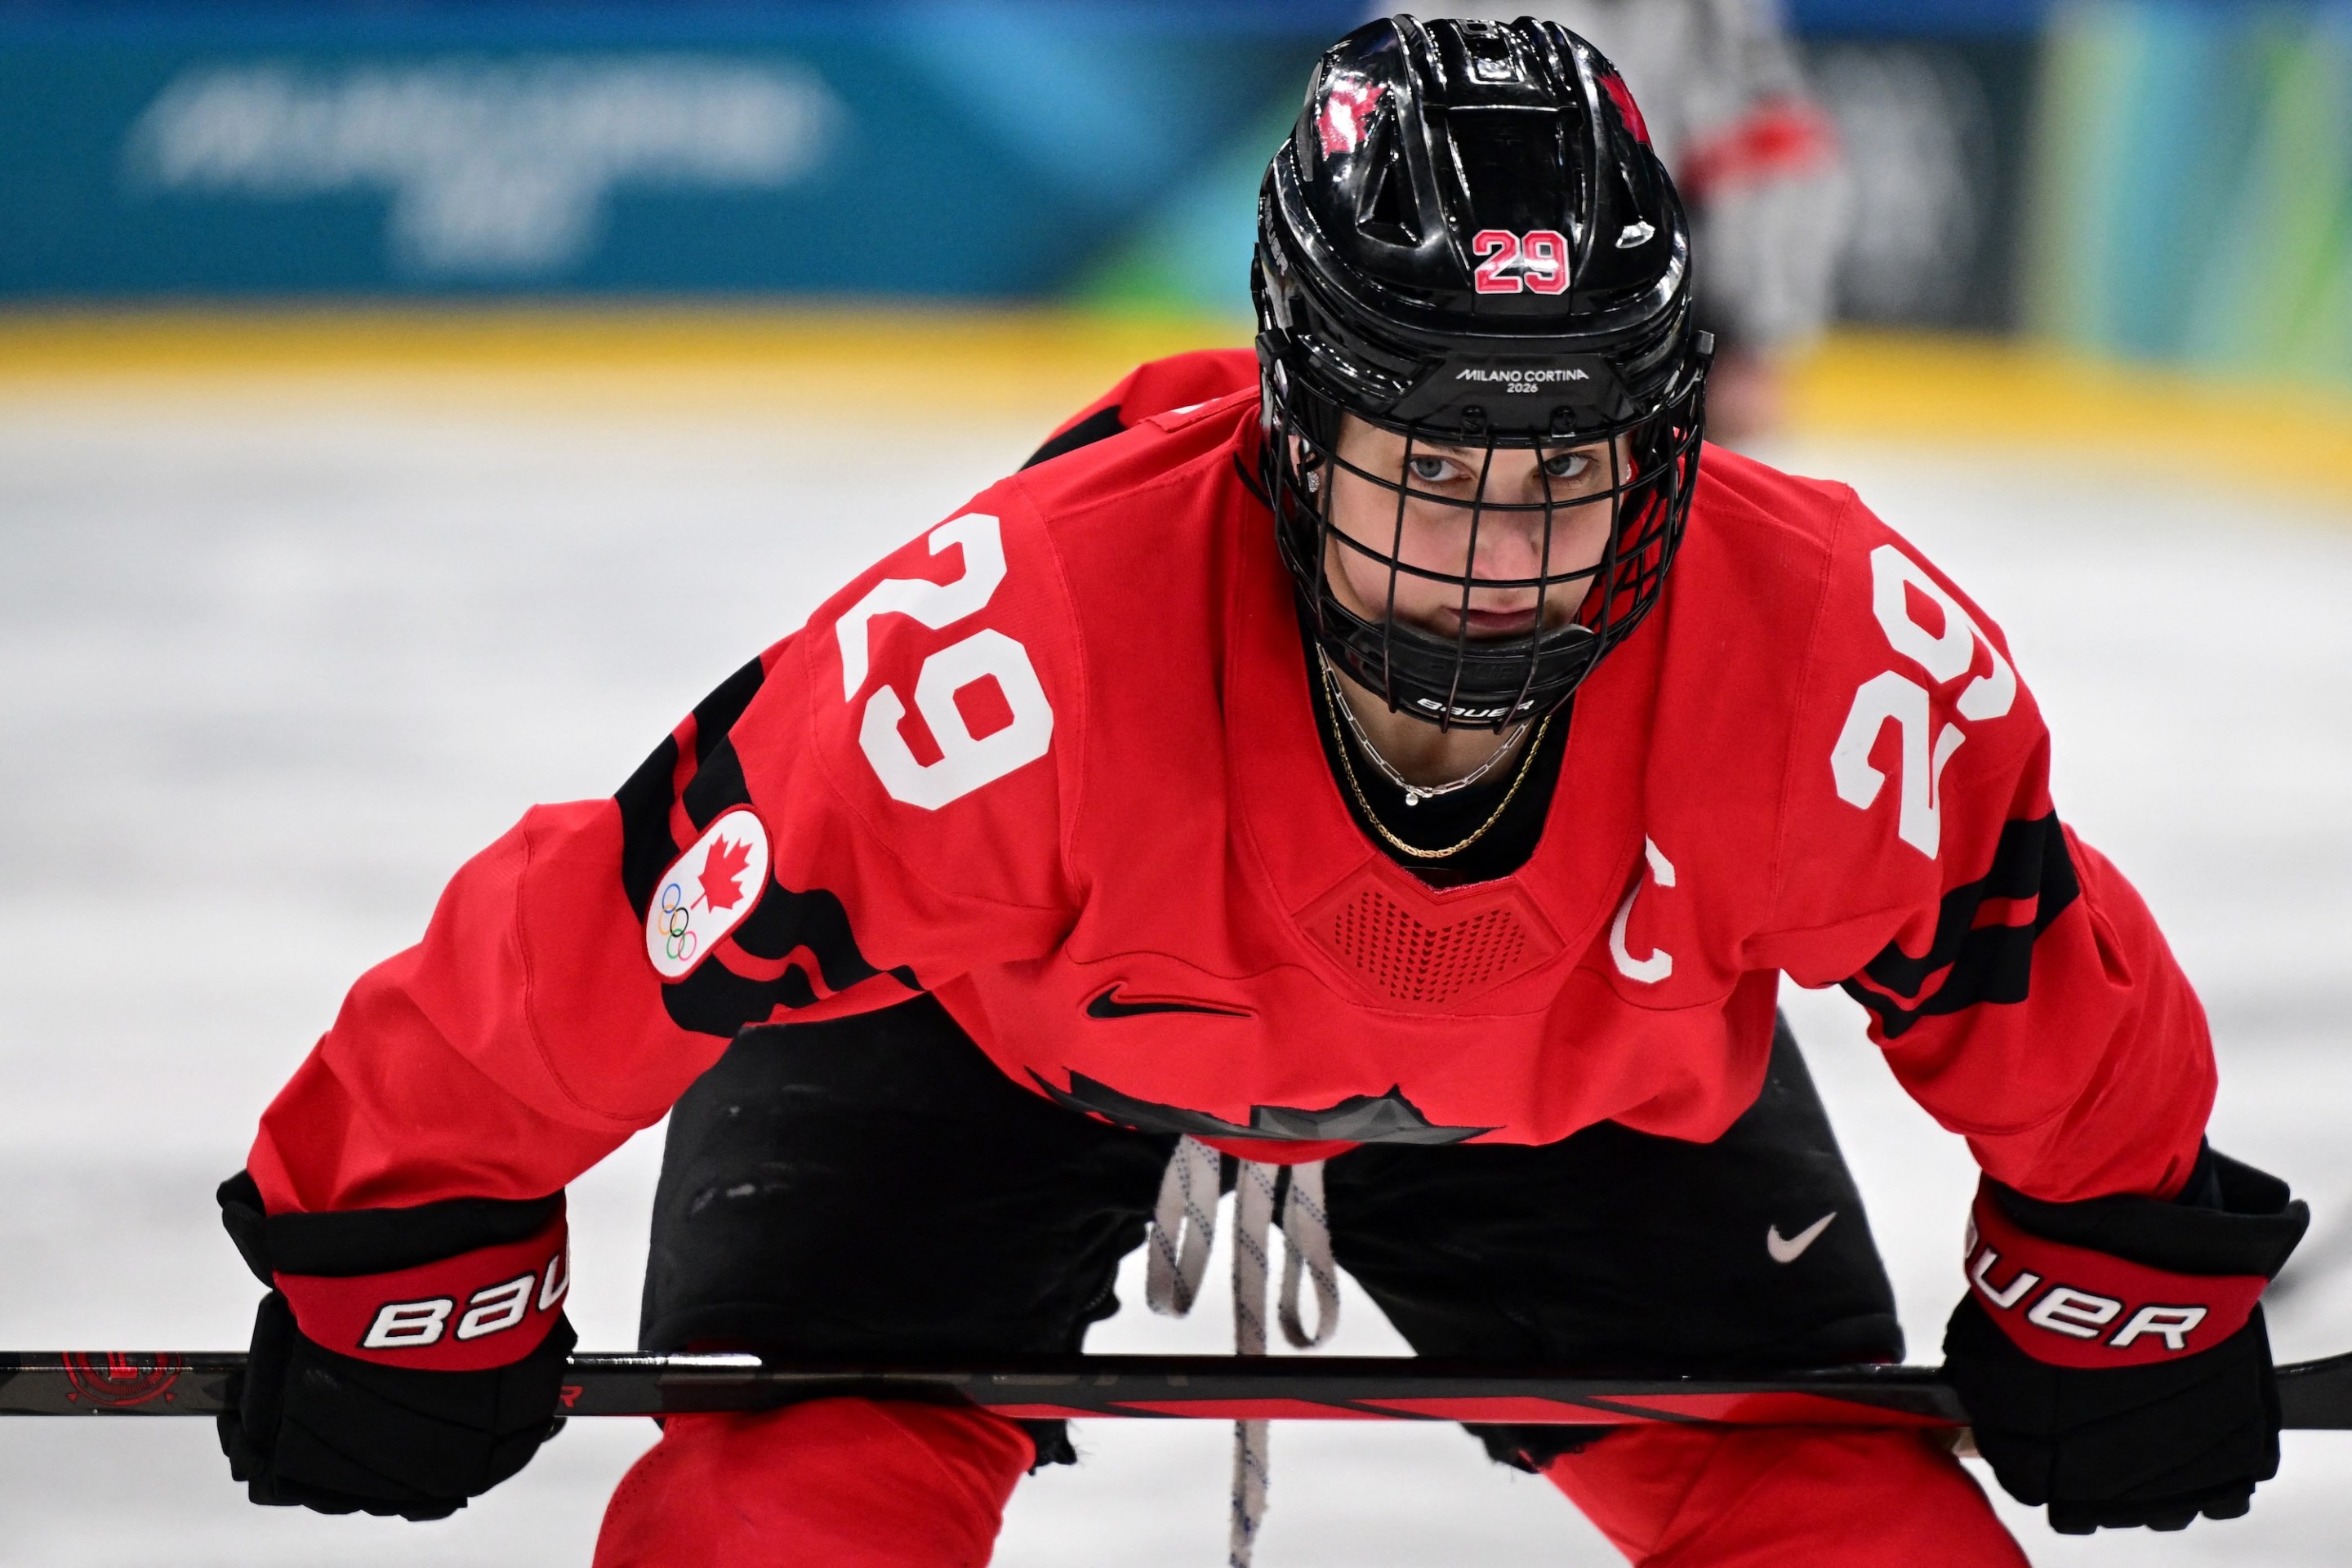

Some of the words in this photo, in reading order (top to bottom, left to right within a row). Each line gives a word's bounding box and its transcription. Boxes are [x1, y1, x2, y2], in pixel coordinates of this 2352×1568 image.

[1472, 229, 1570, 295] 29
[1455, 369, 1521, 382] MILANO
[1524, 369, 1590, 382] CORTINA
[1507, 383, 1539, 394] 2026
[835, 512, 1054, 811] 29
[1830, 544, 2017, 861] 29
[1608, 831, 1676, 984] C
[1965, 1214, 2207, 1350] UER
